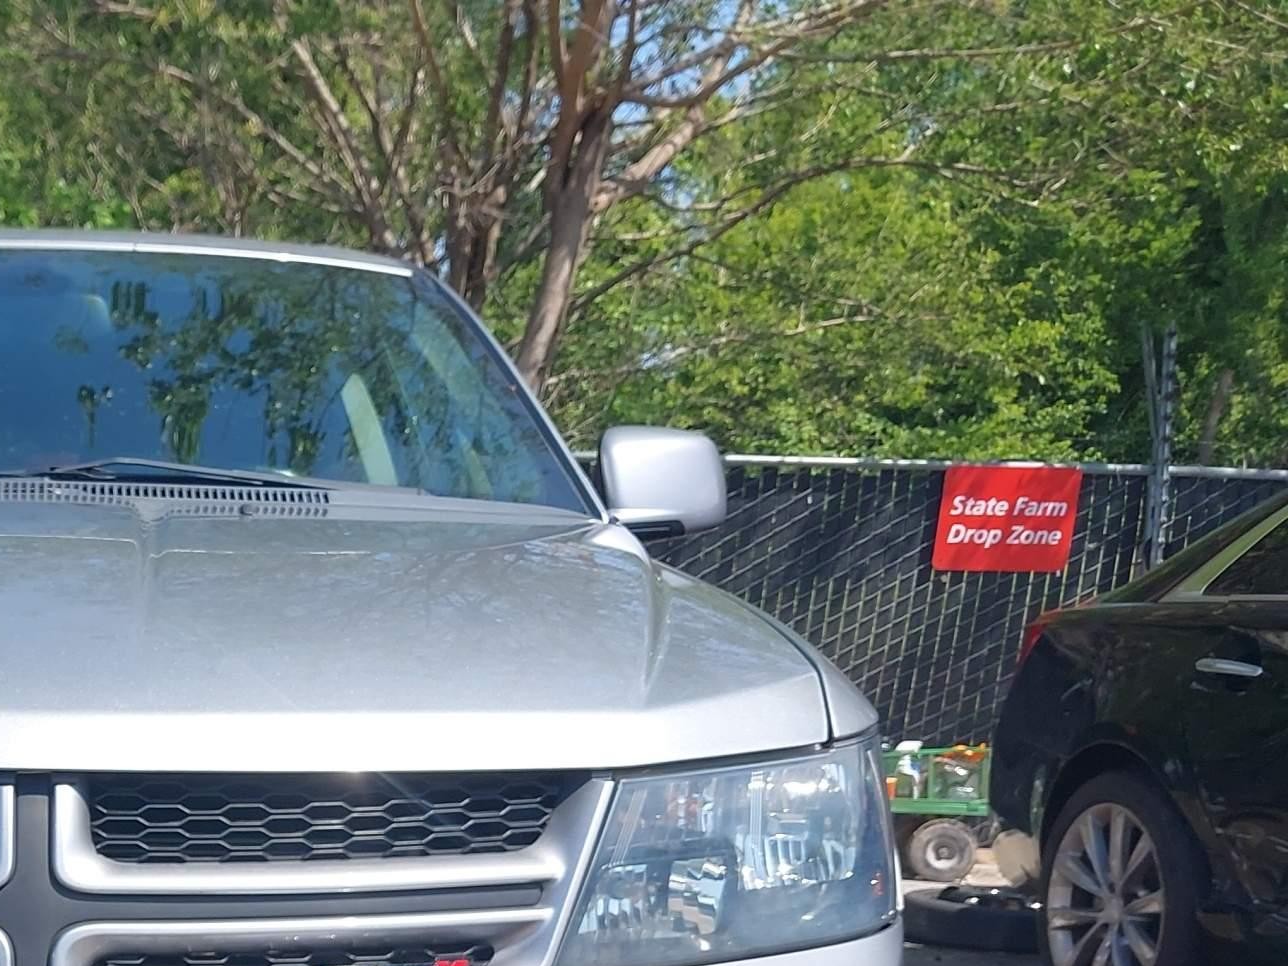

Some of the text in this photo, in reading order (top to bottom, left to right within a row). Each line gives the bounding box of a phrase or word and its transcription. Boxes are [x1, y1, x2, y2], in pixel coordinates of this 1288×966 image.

[950, 496, 1068, 517] State Farm
[947, 524, 1063, 549] Drop Zone
